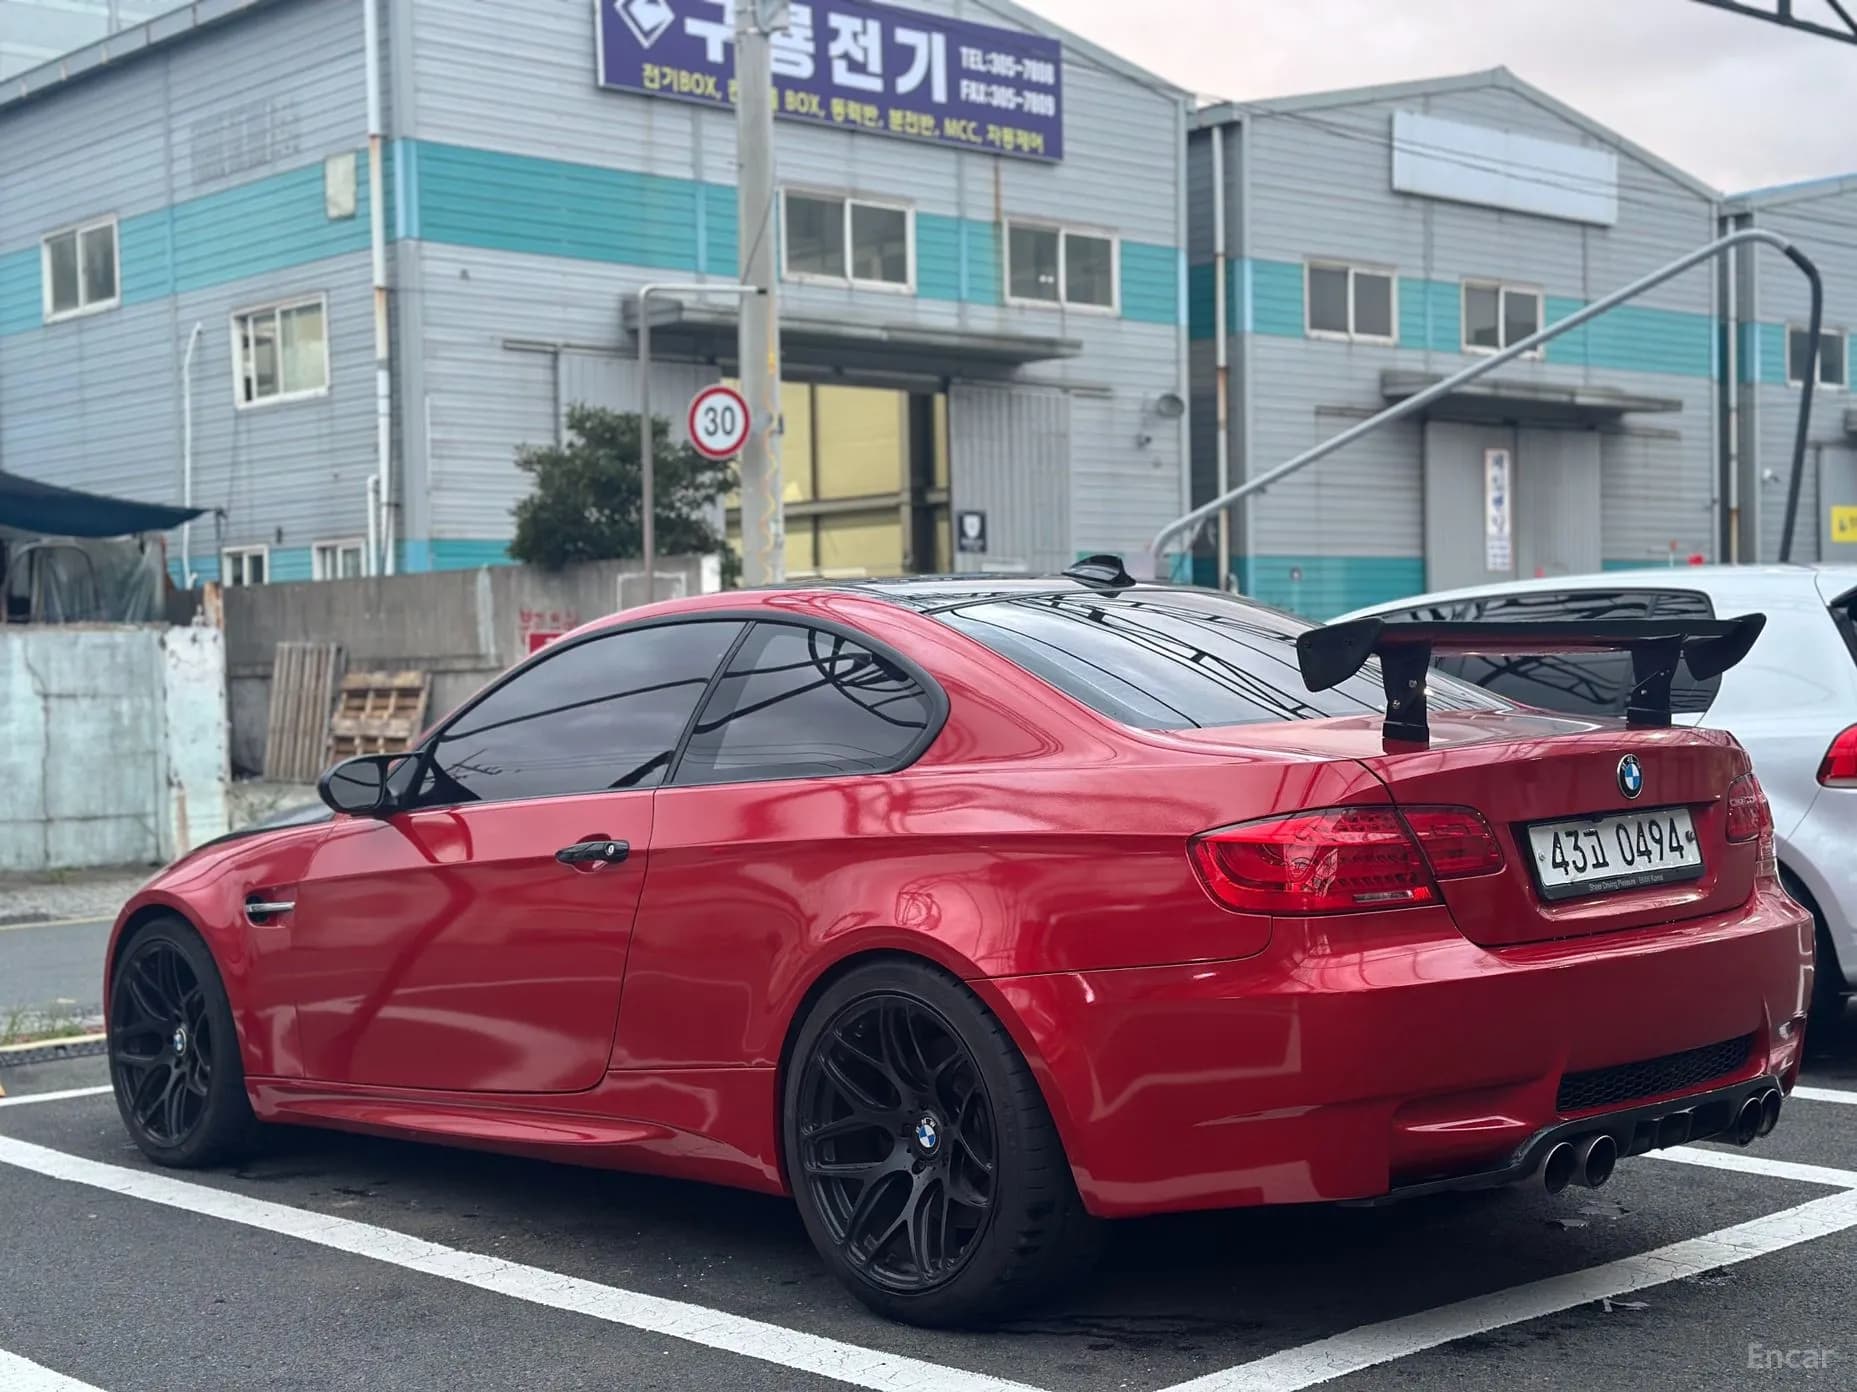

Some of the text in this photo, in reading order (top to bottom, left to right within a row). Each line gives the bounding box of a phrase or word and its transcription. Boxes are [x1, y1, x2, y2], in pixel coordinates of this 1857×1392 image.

[785, 89, 826, 118] BOX,
[704, 406, 736, 437] 30
[1551, 817, 1685, 875] 43고 0494
